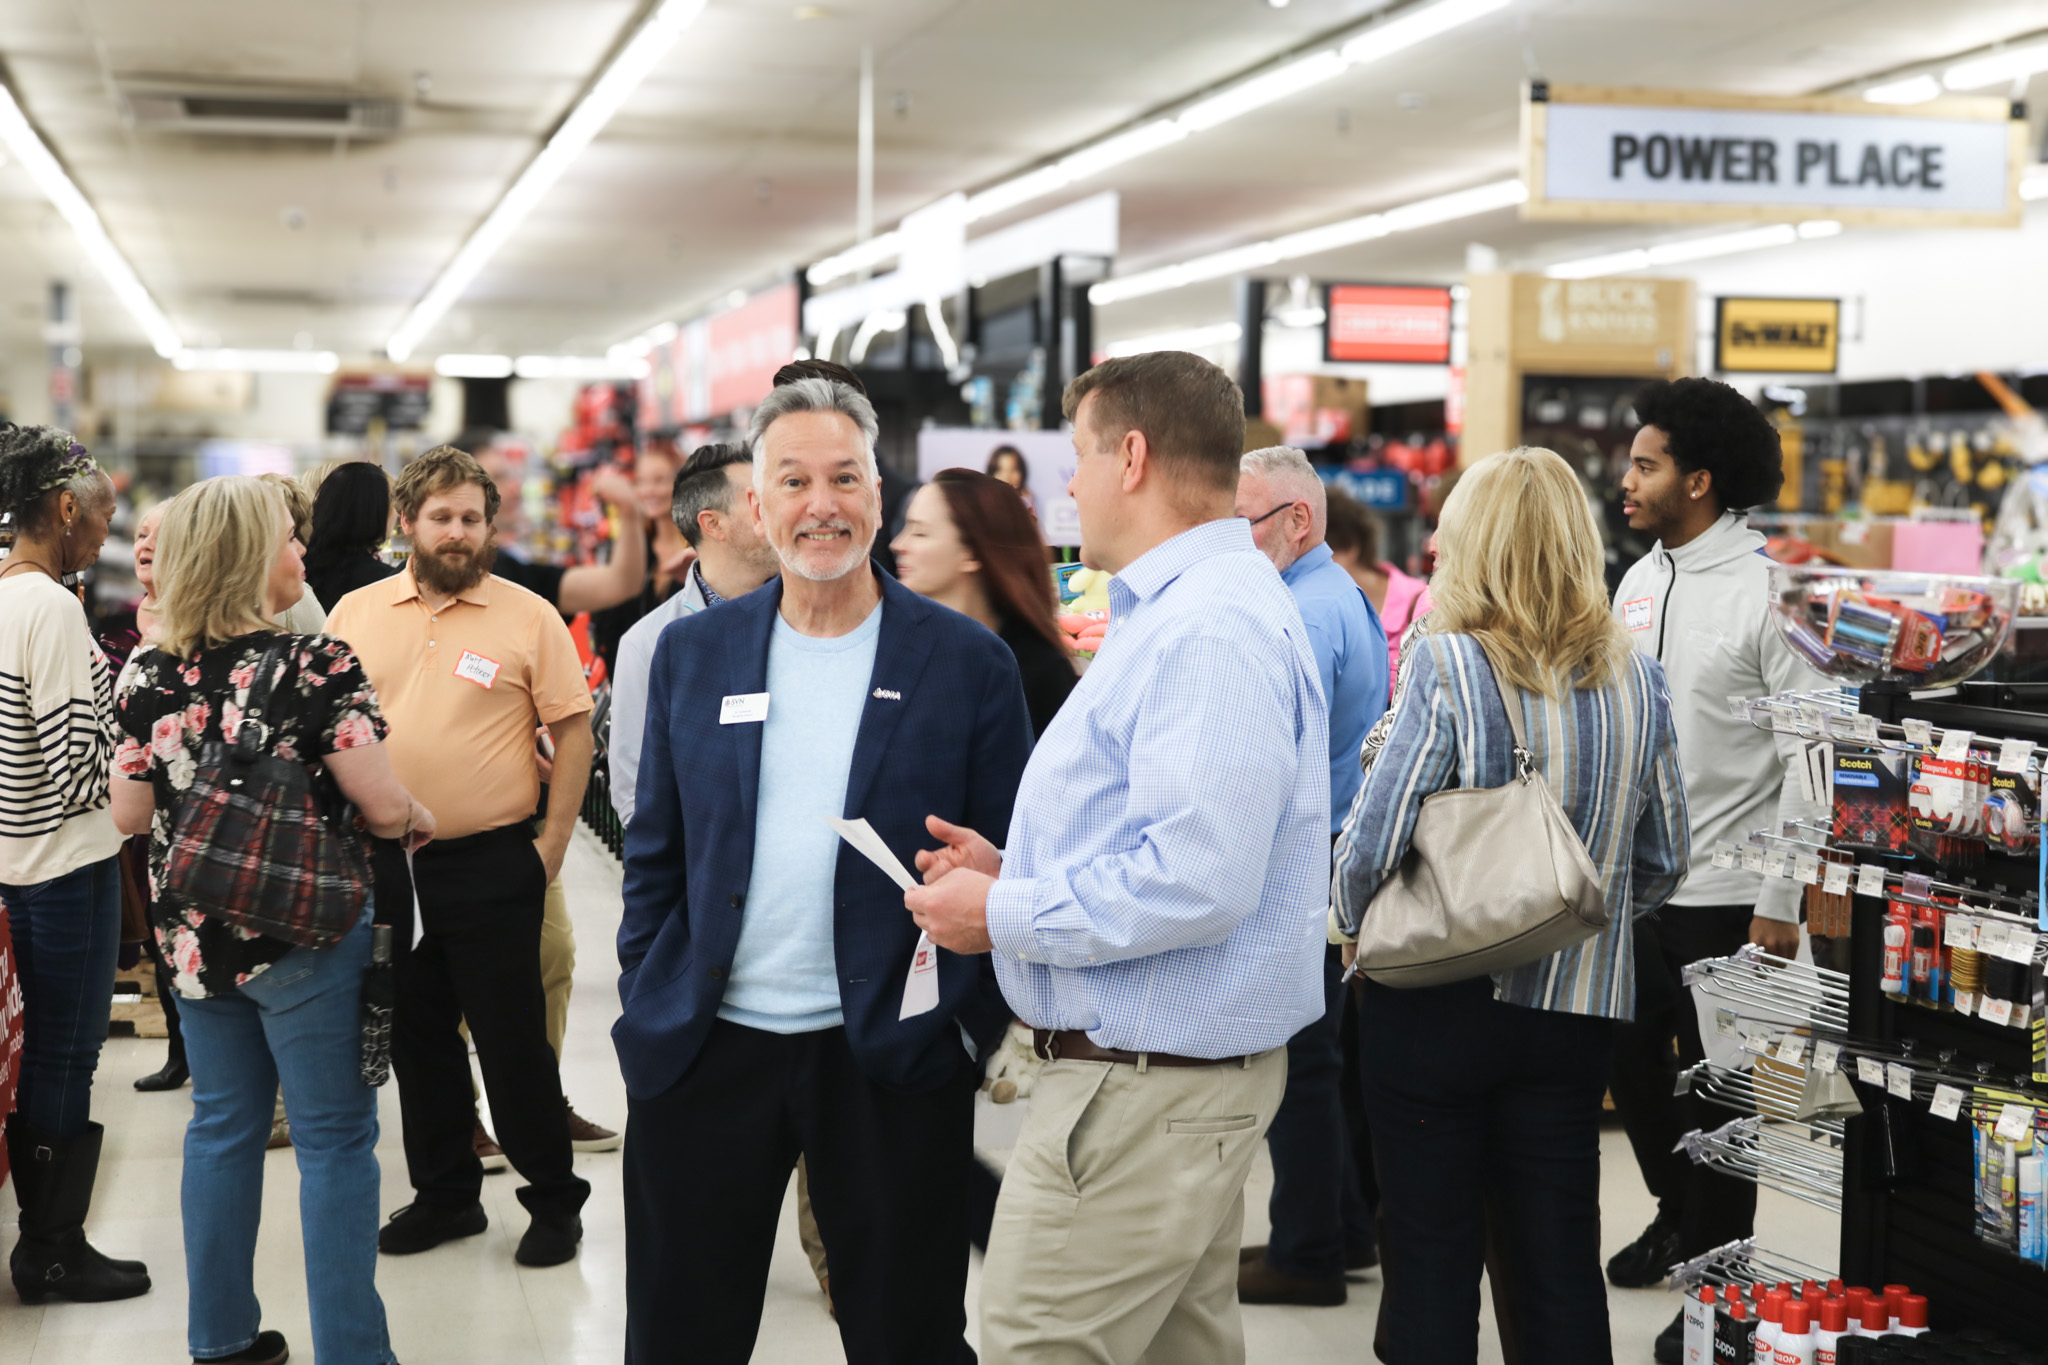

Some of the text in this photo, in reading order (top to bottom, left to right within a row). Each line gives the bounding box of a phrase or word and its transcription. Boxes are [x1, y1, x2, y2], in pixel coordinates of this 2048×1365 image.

[1612, 133, 1943, 190] POWER PLACE
[1839, 758, 1872, 769] Scotch
[1921, 761, 1948, 775] Transparent
[1992, 776, 2016, 789] Scotch
[1915, 819, 1933, 828] Scotch
[1689, 1315, 1704, 1329] ZIPPO
